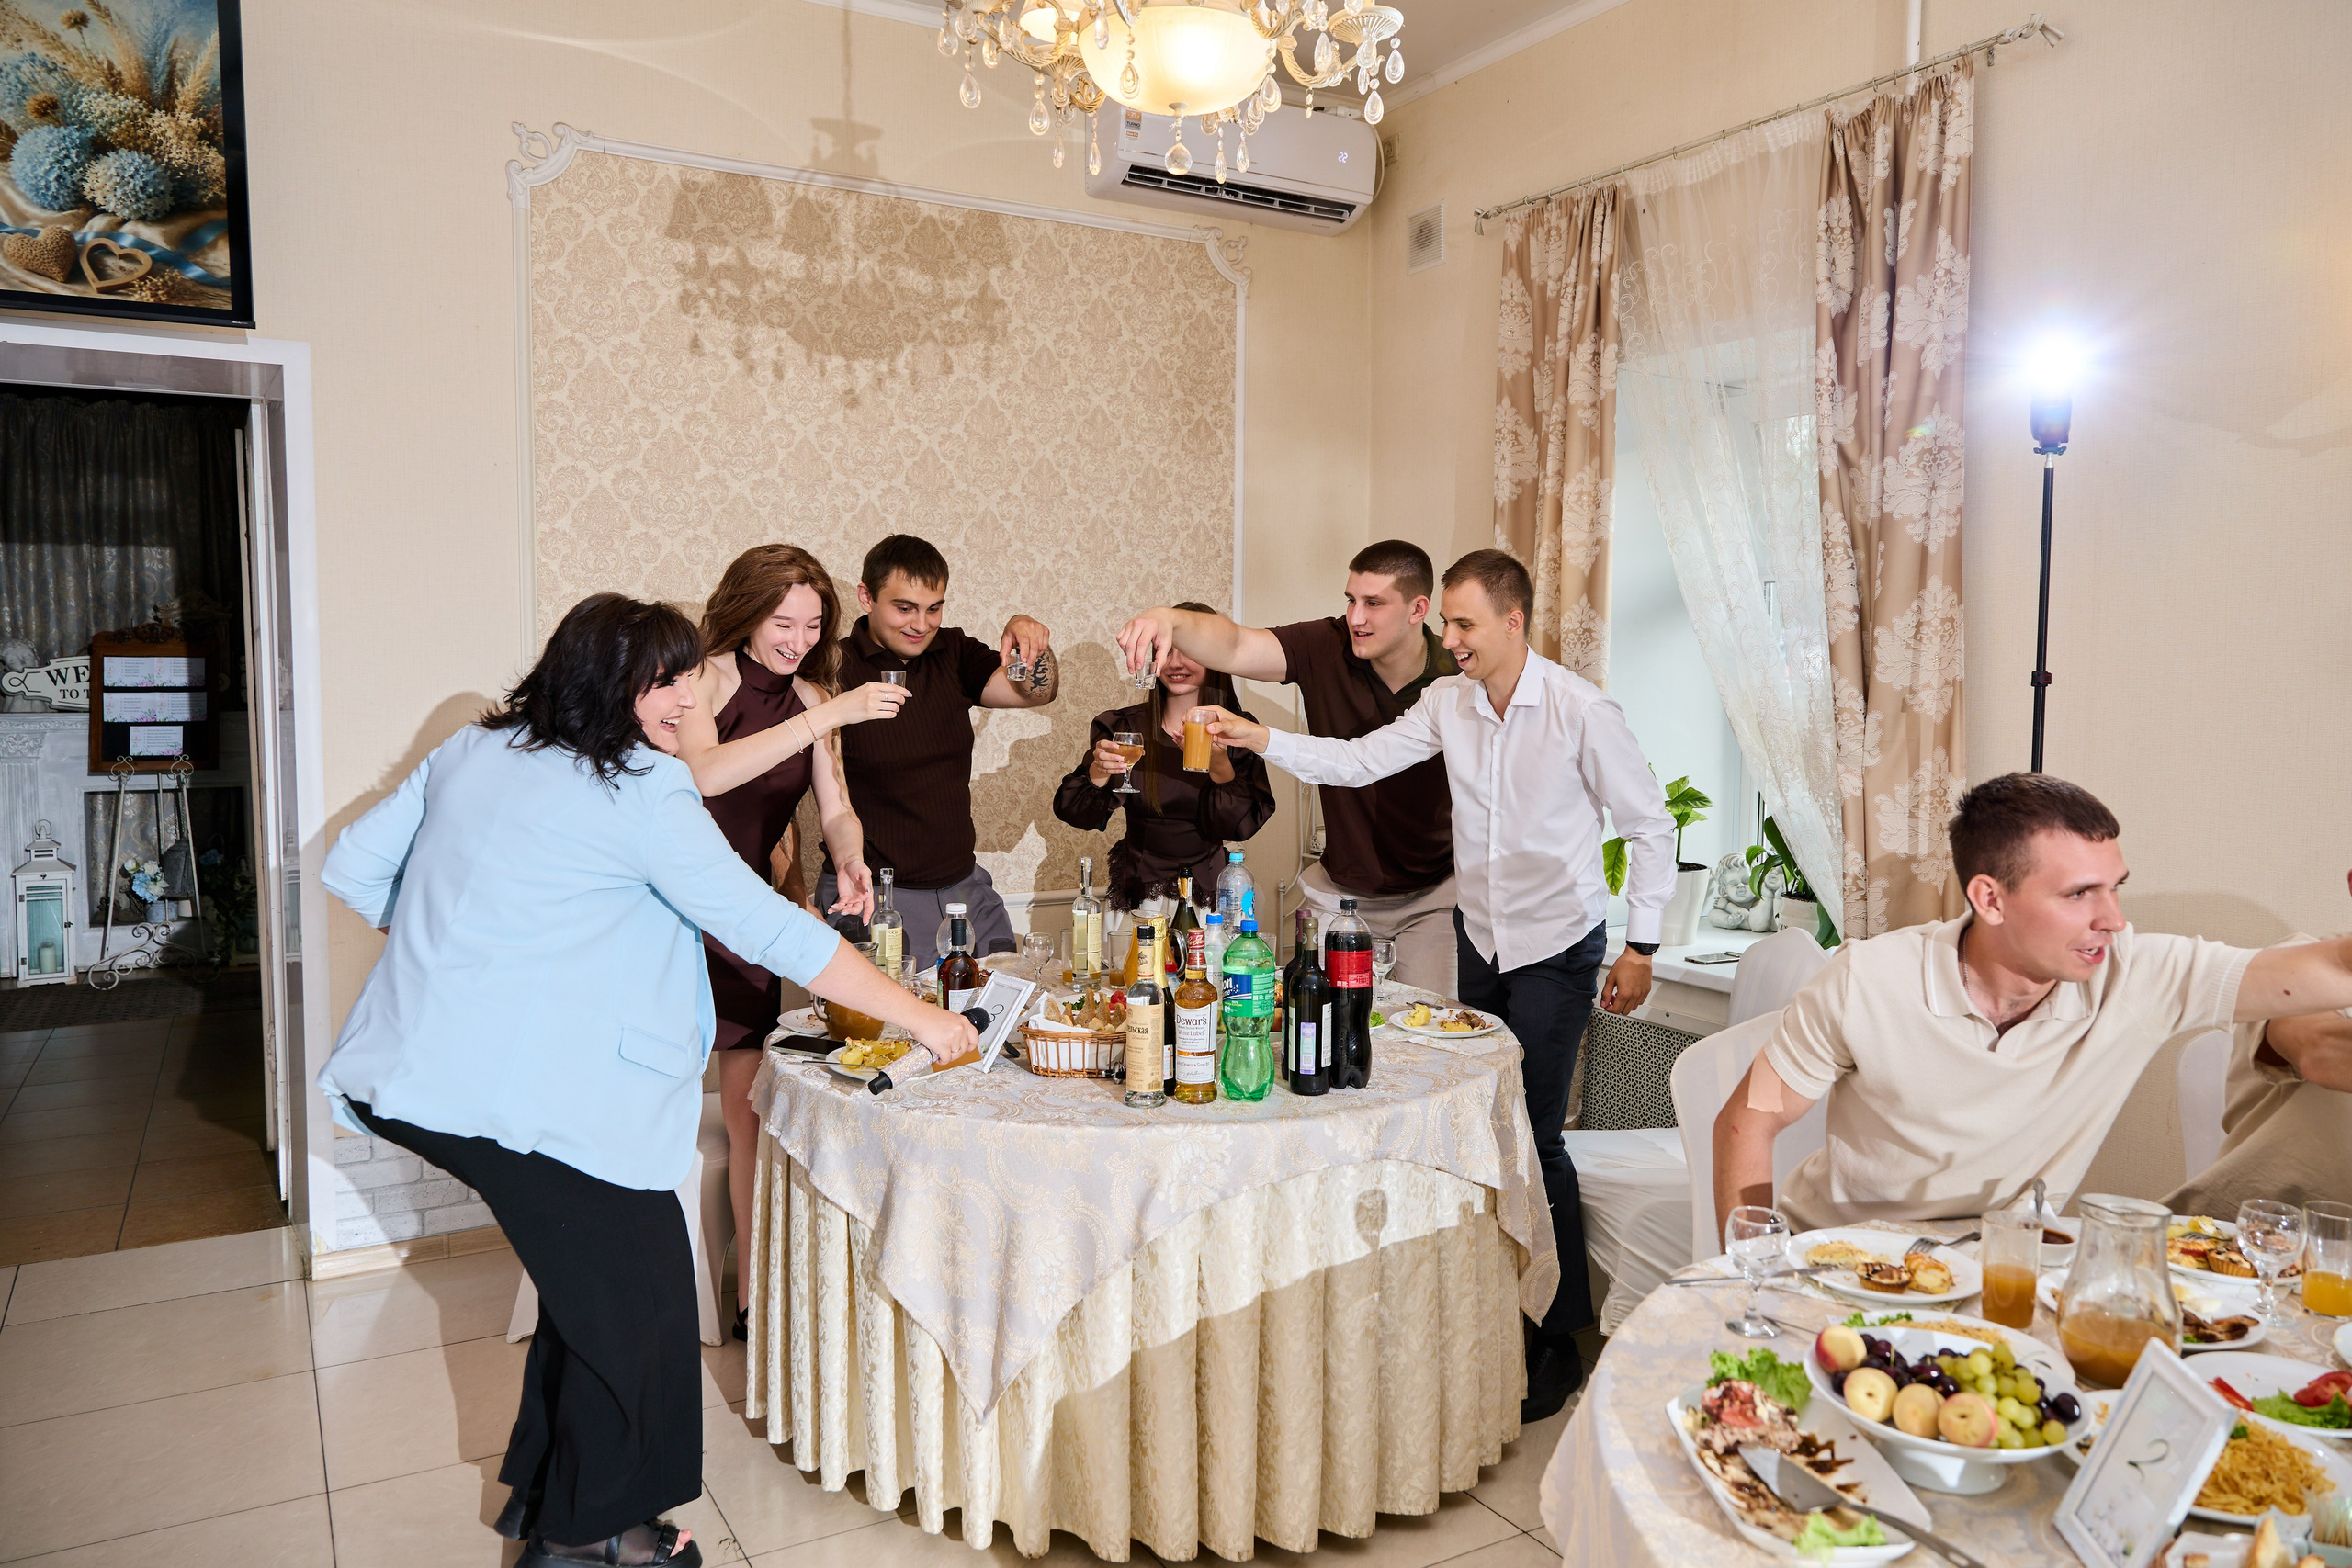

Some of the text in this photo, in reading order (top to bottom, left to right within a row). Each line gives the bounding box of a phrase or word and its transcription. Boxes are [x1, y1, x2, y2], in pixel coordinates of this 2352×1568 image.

[1338, 152, 1349, 164] 22
[44, 665, 91, 686] WE
[60, 689, 80, 699] TO
[989, 1004, 1005, 1024] 3
[1176, 1014, 1207, 1026] Dewar's
[2126, 1438, 2171, 1484] 2
